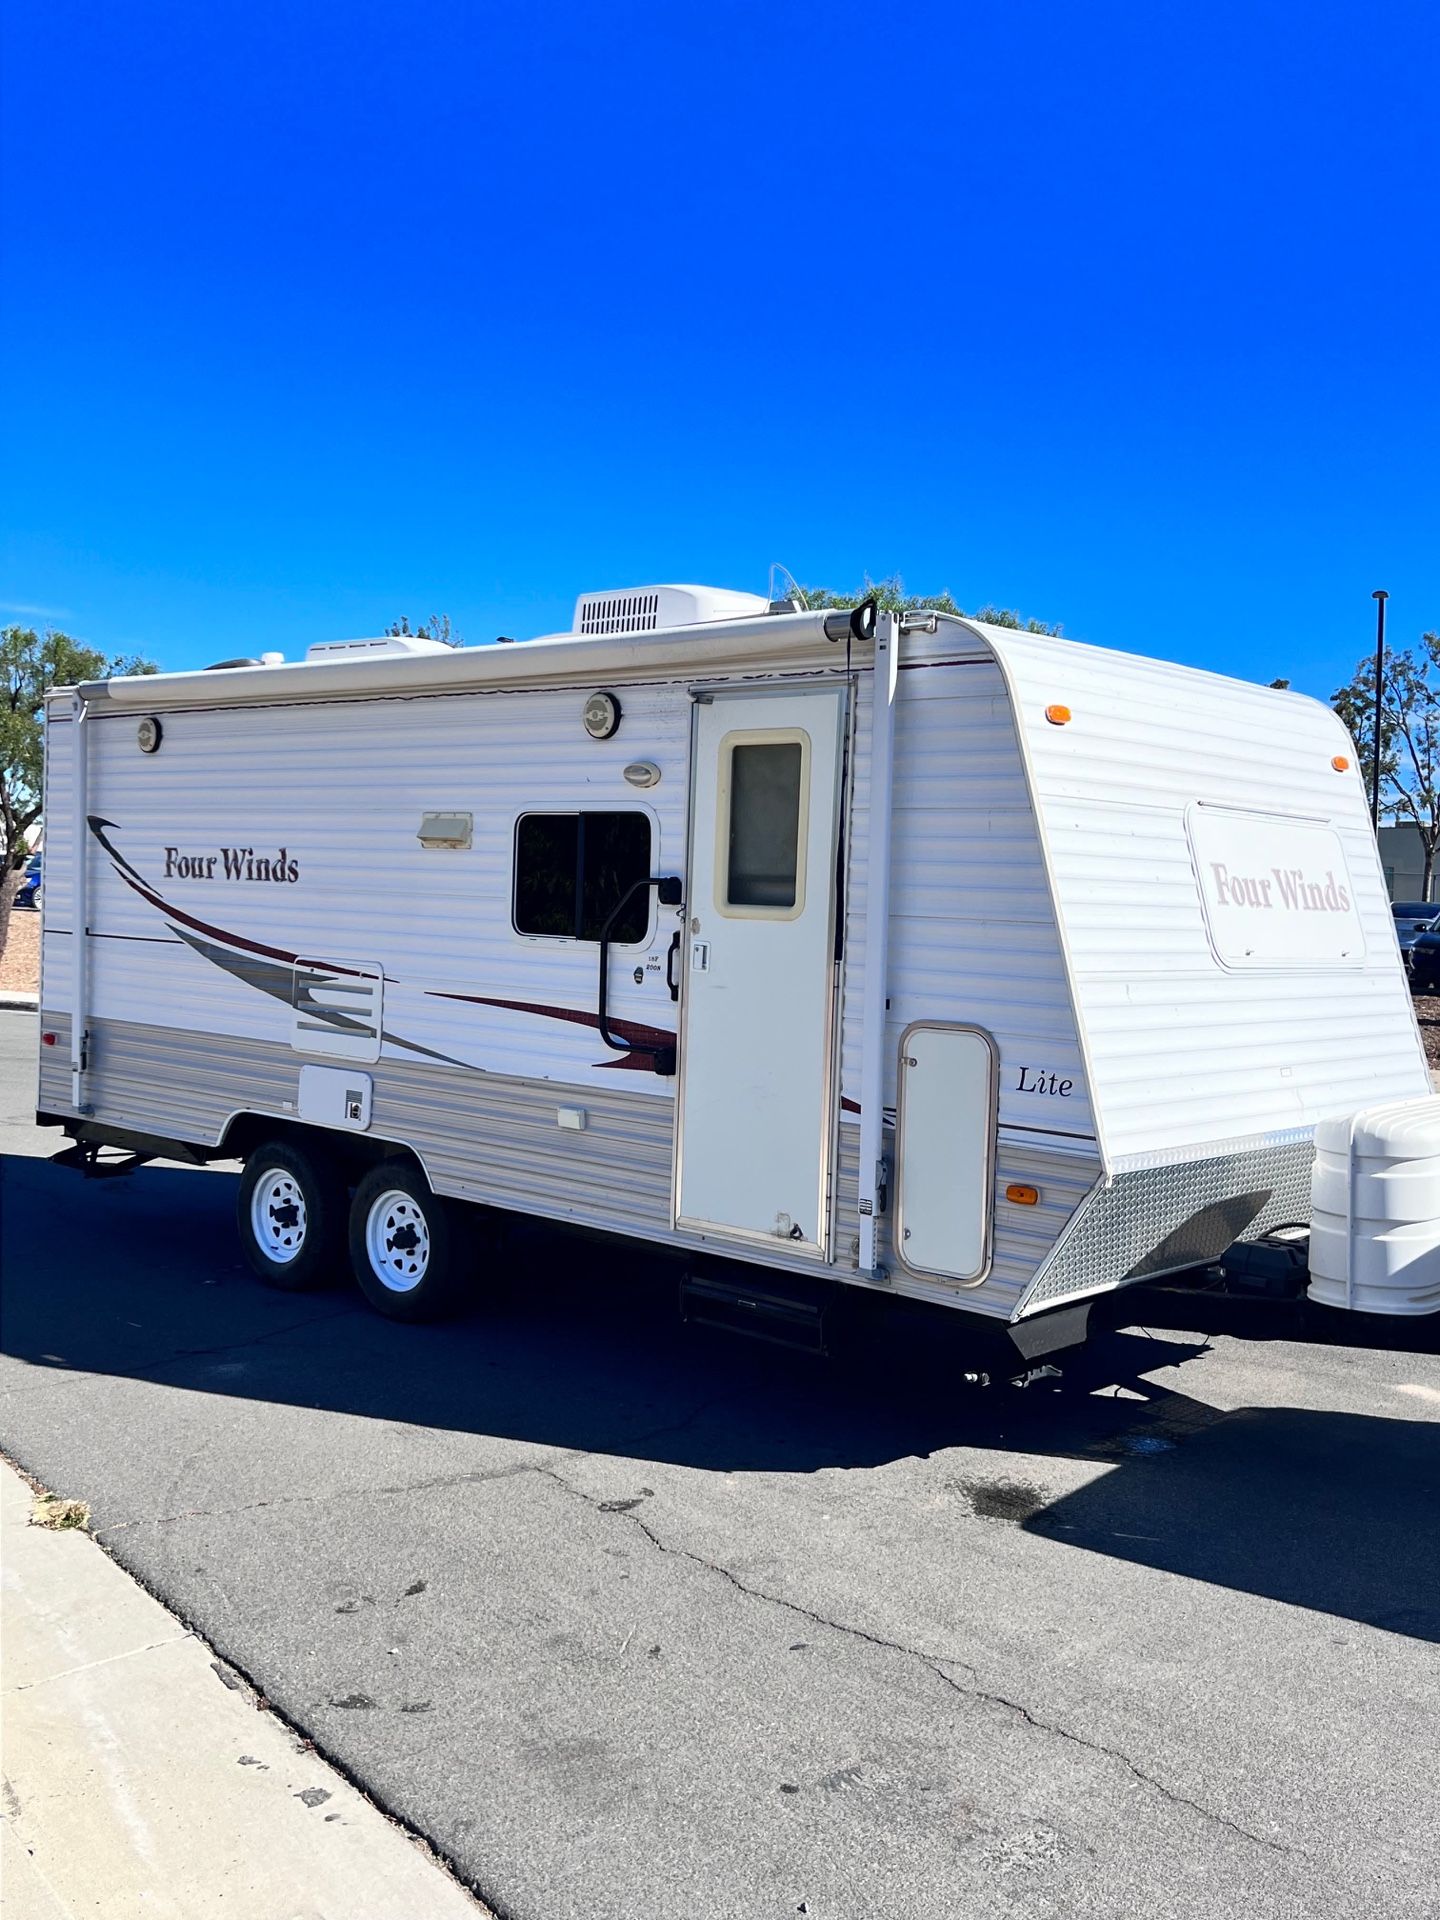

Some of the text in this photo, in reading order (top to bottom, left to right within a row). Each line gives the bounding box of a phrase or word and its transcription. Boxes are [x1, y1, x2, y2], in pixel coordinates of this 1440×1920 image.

[163, 847, 299, 883] Four Winds
[1210, 862, 1350, 912] Four Winds
[1015, 1066, 1073, 1097] Lite
